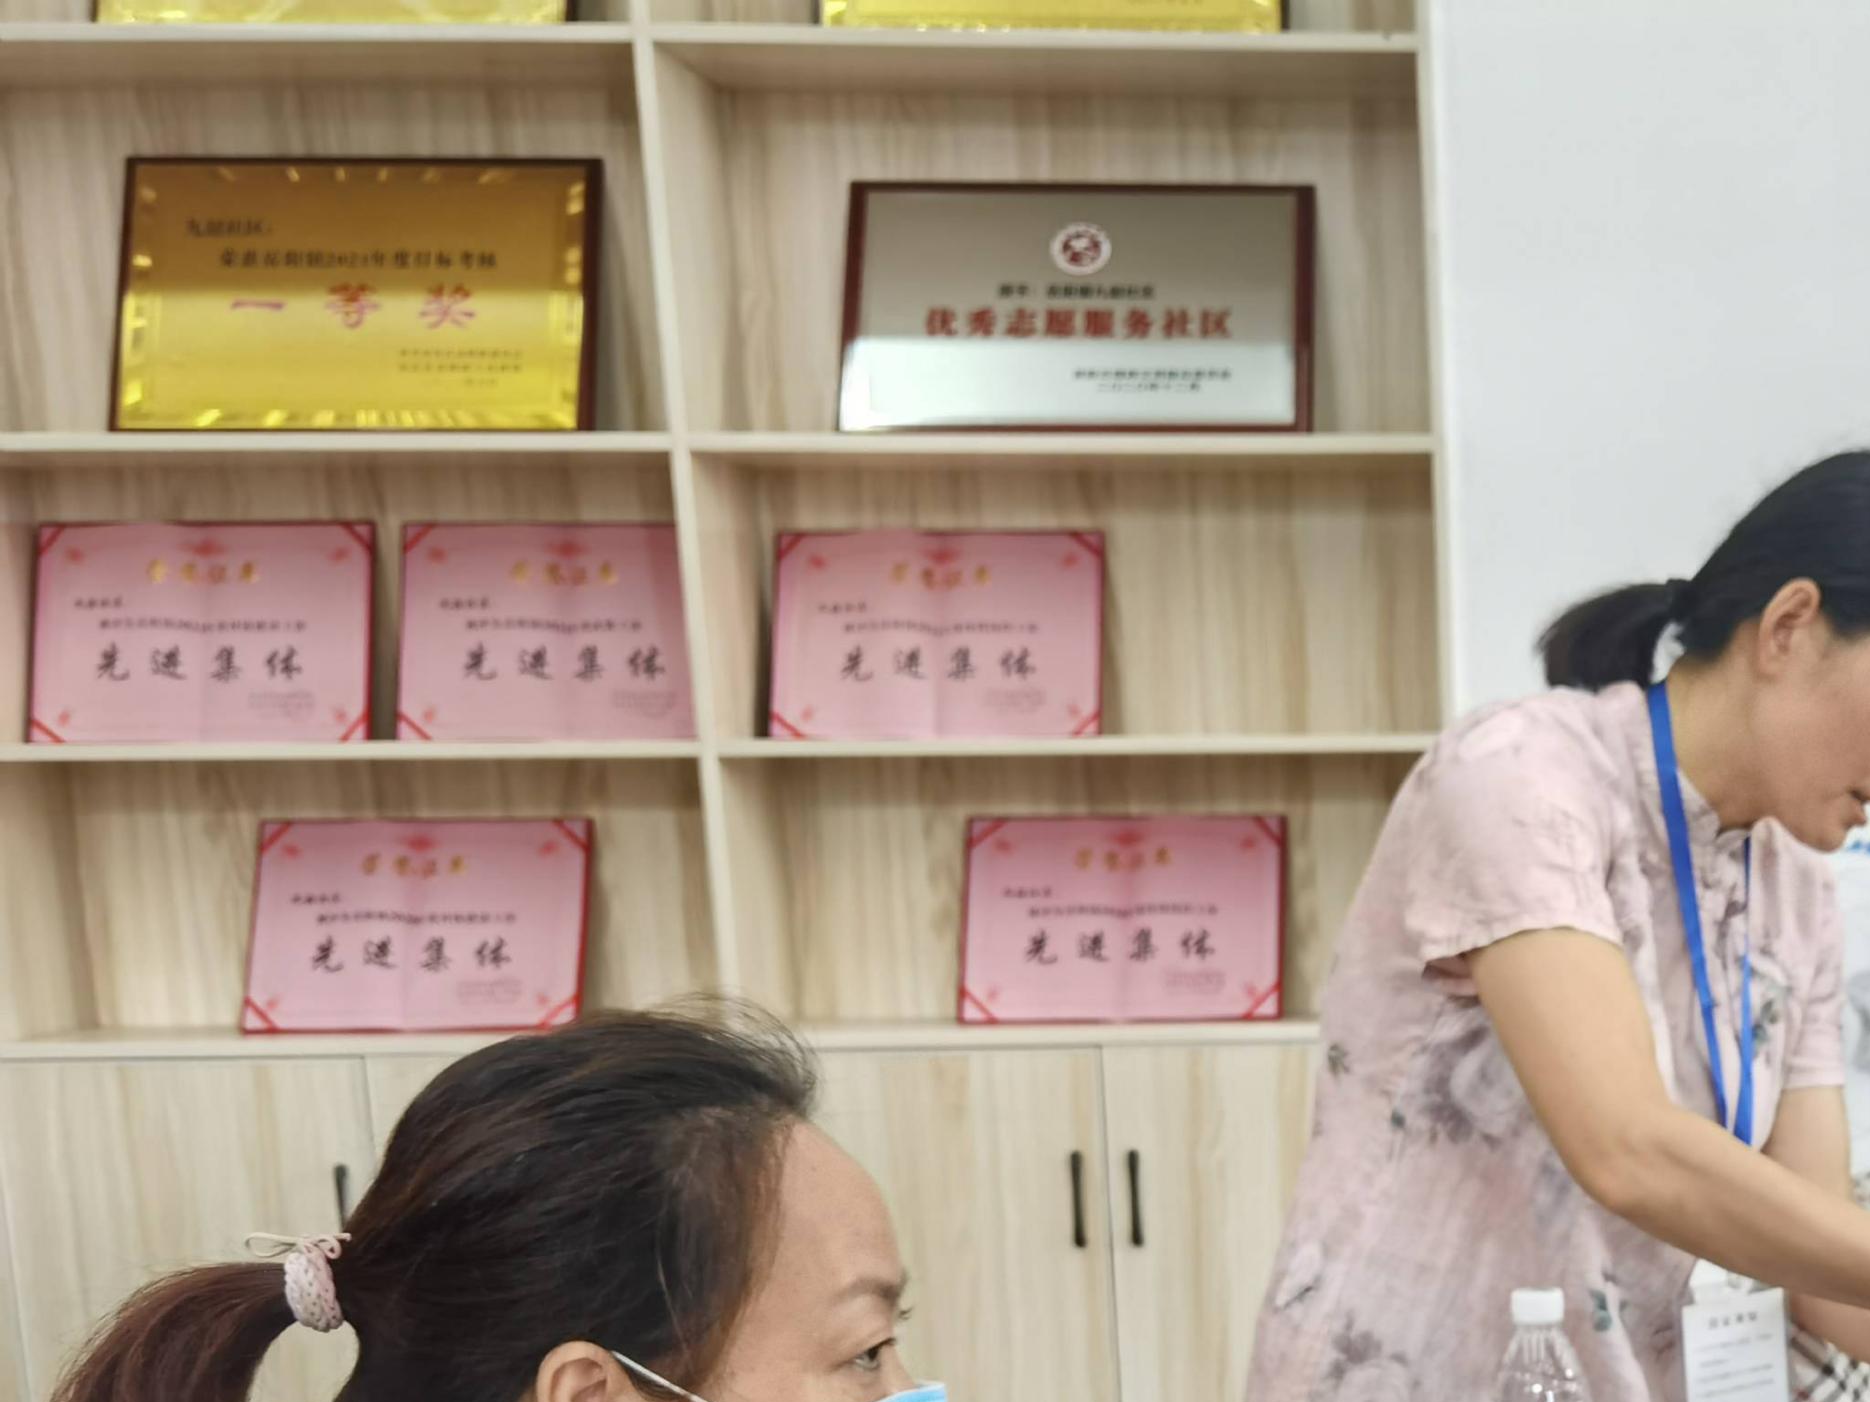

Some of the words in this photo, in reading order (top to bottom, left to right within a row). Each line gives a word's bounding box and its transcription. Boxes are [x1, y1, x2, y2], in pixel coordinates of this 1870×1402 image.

[229, 281, 477, 330] 一等奖
[924, 306, 1233, 338] 优秀志愿服务社区
[97, 642, 304, 683] 先进集体
[462, 642, 667, 683] 先进集体
[839, 645, 1037, 683] 先进集体
[311, 936, 512, 973] 先进集体
[1024, 928, 1217, 965] 先进集体
